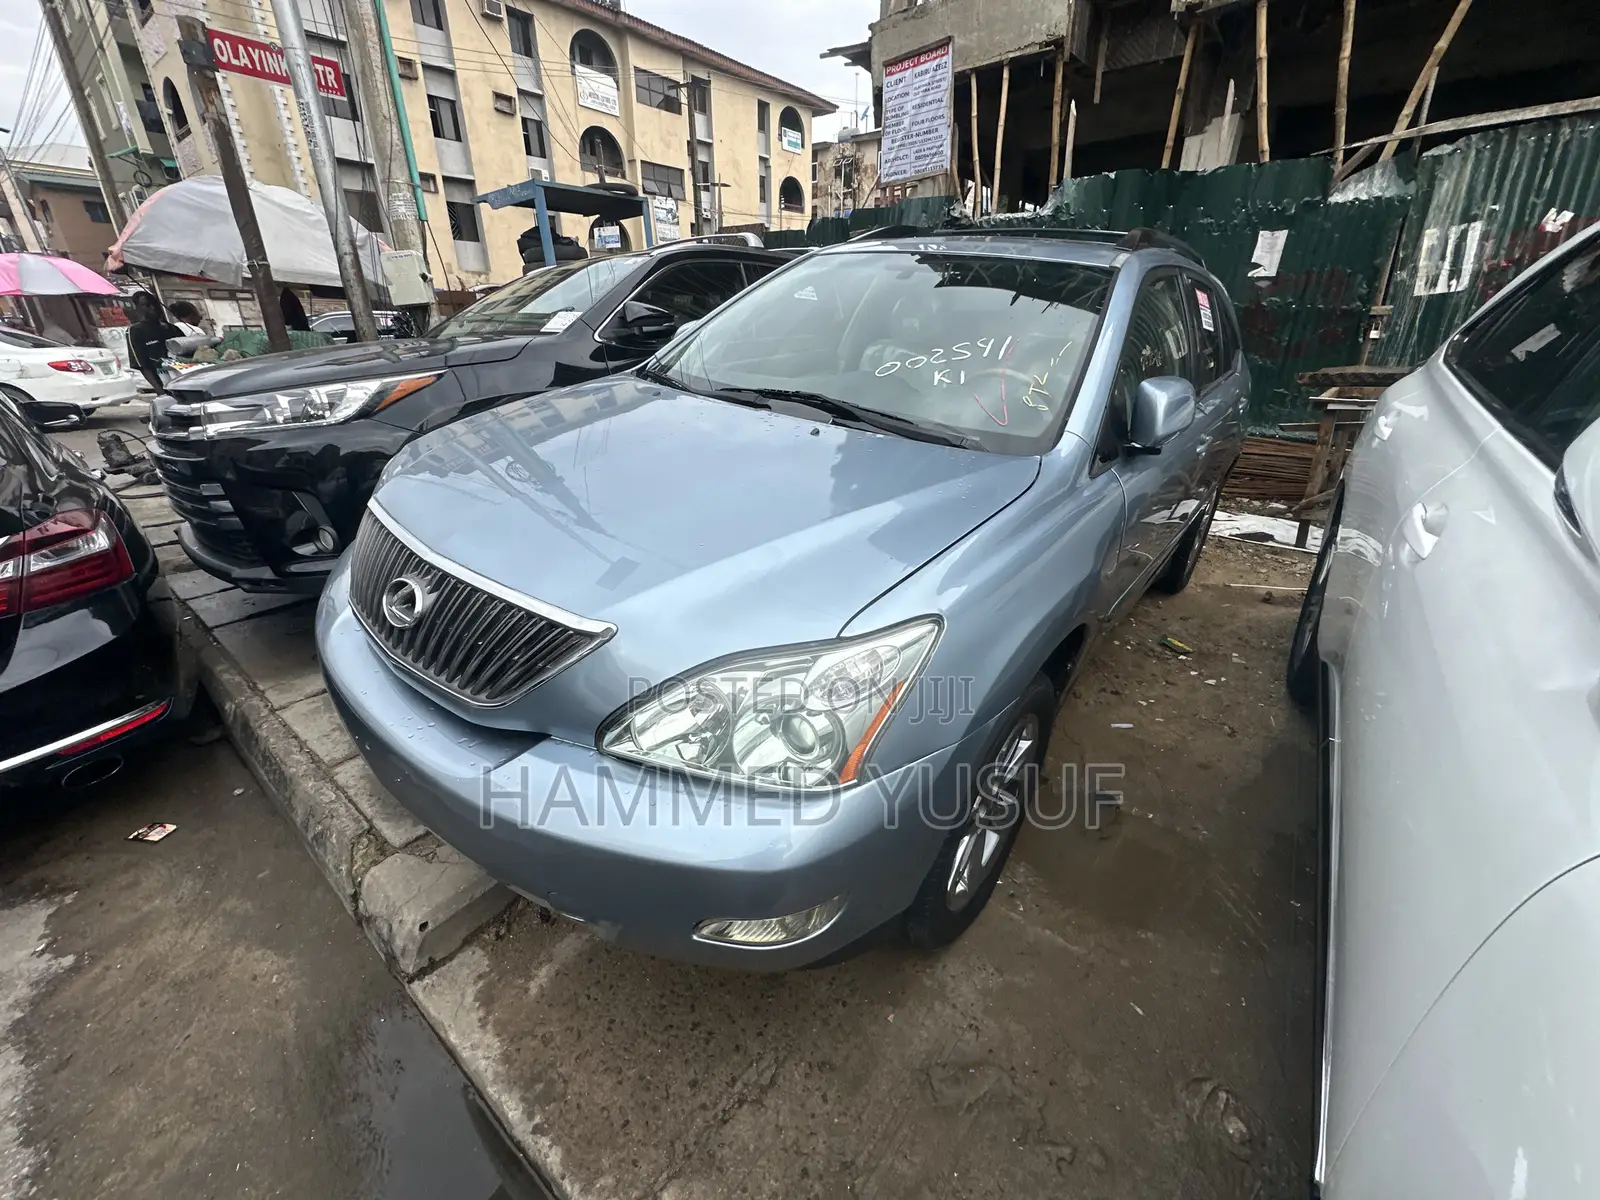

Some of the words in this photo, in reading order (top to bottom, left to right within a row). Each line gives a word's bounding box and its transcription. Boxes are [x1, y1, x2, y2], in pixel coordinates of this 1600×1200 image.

[213, 37, 290, 77] OLAYINK
[314, 63, 339, 89] TR
[886, 55, 919, 75] PROJECT
[920, 45, 948, 63] BOARD
